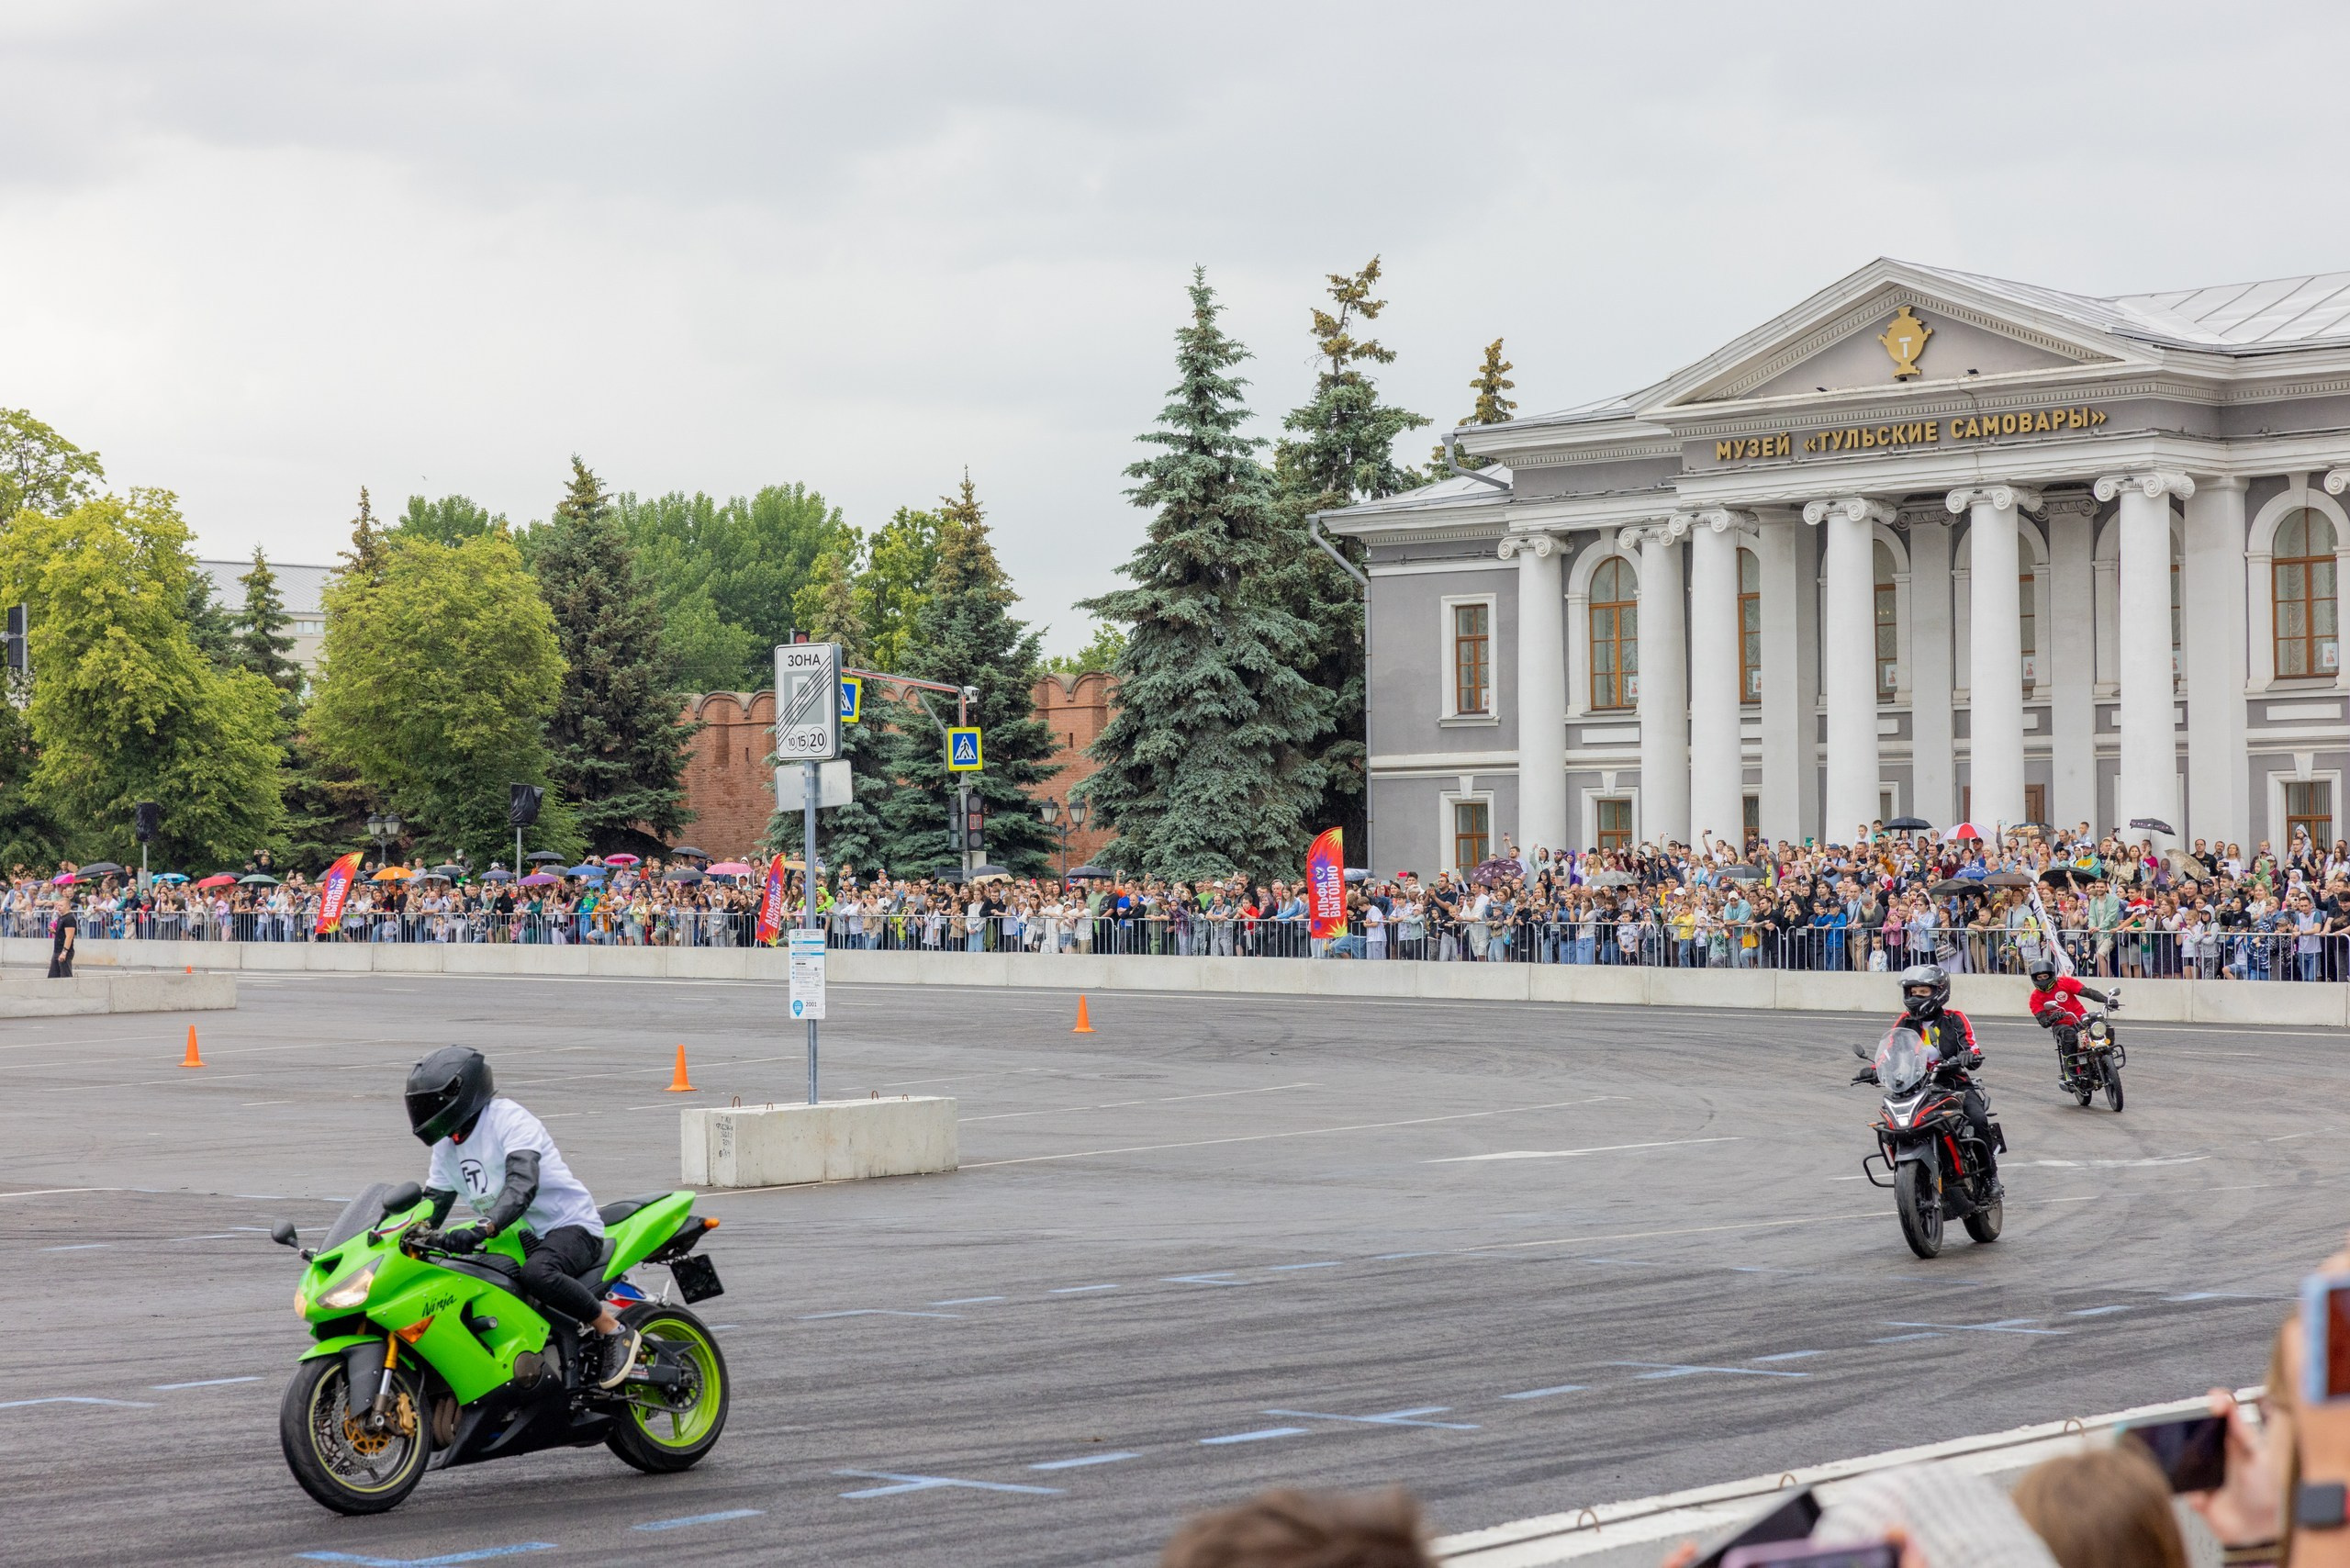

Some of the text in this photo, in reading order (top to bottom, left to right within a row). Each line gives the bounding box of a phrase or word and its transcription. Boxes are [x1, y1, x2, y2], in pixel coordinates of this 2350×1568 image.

[1716, 407, 2108, 461] МУЗЕЙ «ТУЛЬСКИЕ САМОВАРЫ»
[788, 654, 822, 666] ЗОНА
[788, 733, 825, 747] 10 15 20
[323, 890, 335, 918] АЛЬФА
[330, 879, 347, 918] ВЫГОДНО
[771, 883, 782, 929] ВЫГОДНО
[1316, 881, 1330, 918] АЛЬФА
[1326, 865, 1341, 918] ВЫГОДНО
[765, 894, 777, 926] АЛЬФА
[421, 1292, 458, 1318] Ninja
